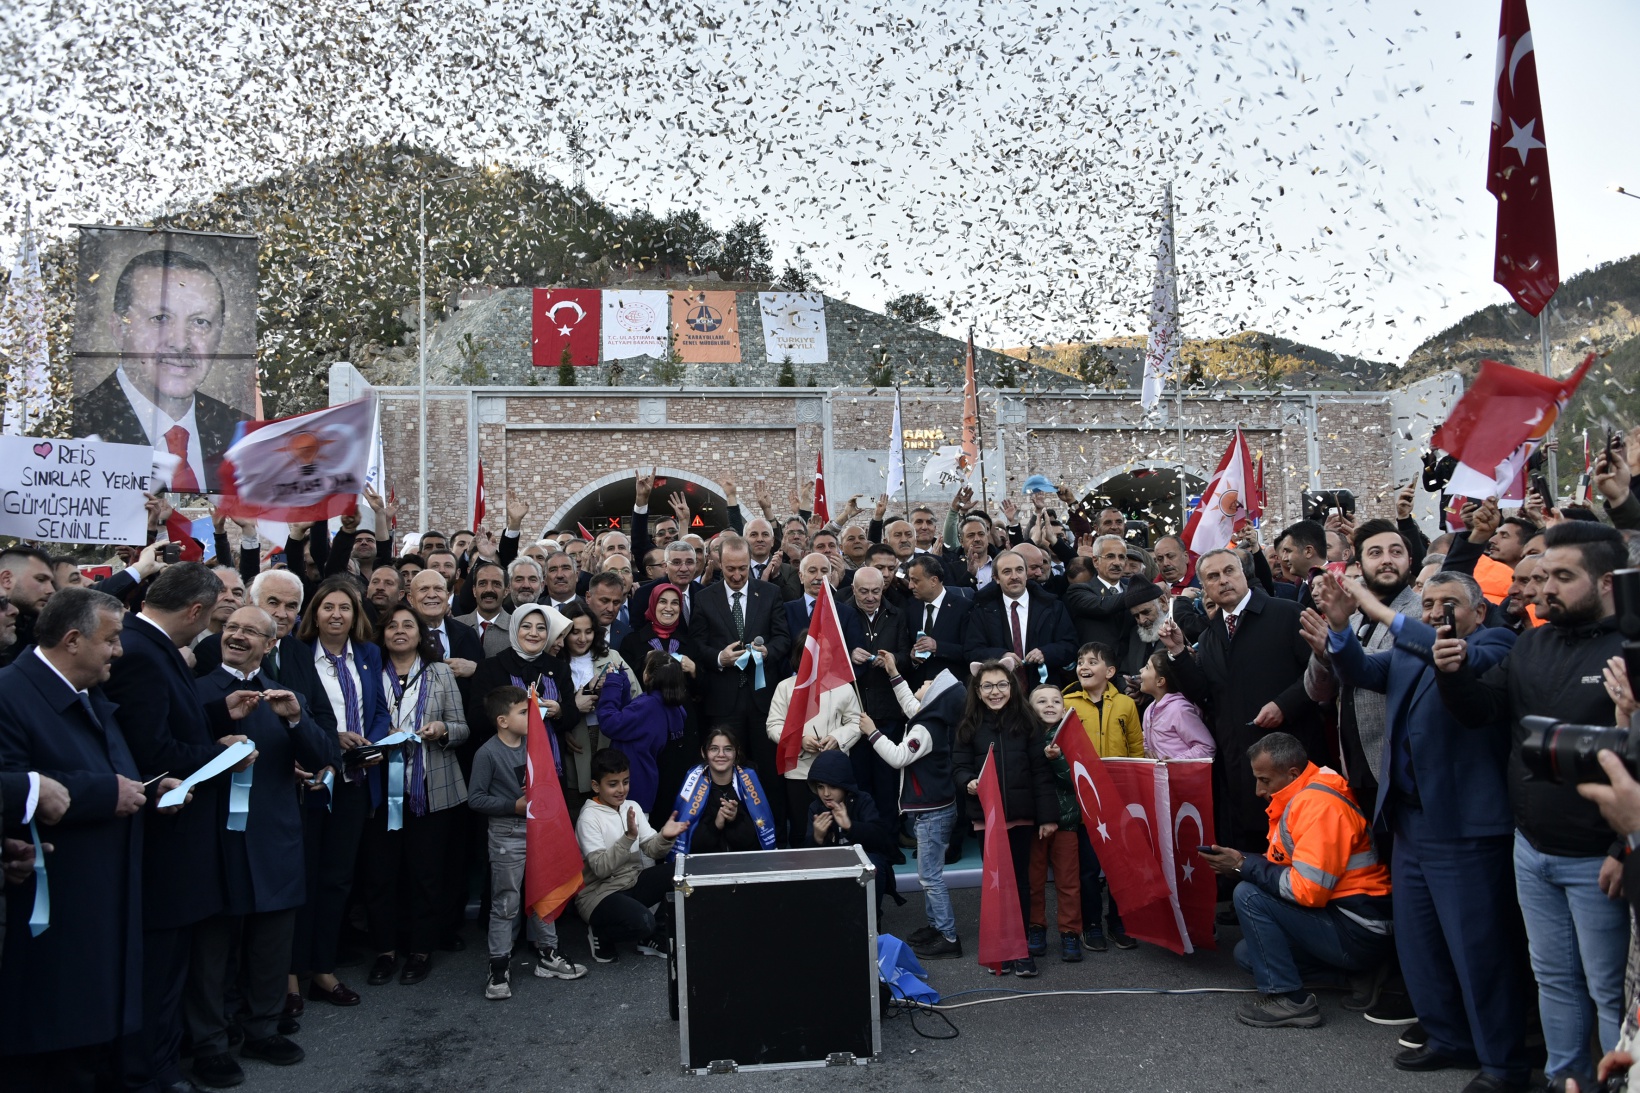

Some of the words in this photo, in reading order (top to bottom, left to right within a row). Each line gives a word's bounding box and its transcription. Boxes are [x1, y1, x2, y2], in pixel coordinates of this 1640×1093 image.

[890, 429, 946, 440] GANA
[902, 440, 935, 449] ÜNELİ
[58, 444, 96, 466] REİS
[21, 467, 91, 488] SINIRLAR
[102, 471, 150, 490] YERİNE
[4, 491, 111, 517] GÜMÜŞHANE
[689, 783, 709, 816] DOĞRU
[741, 773, 761, 806] DOĞRU
